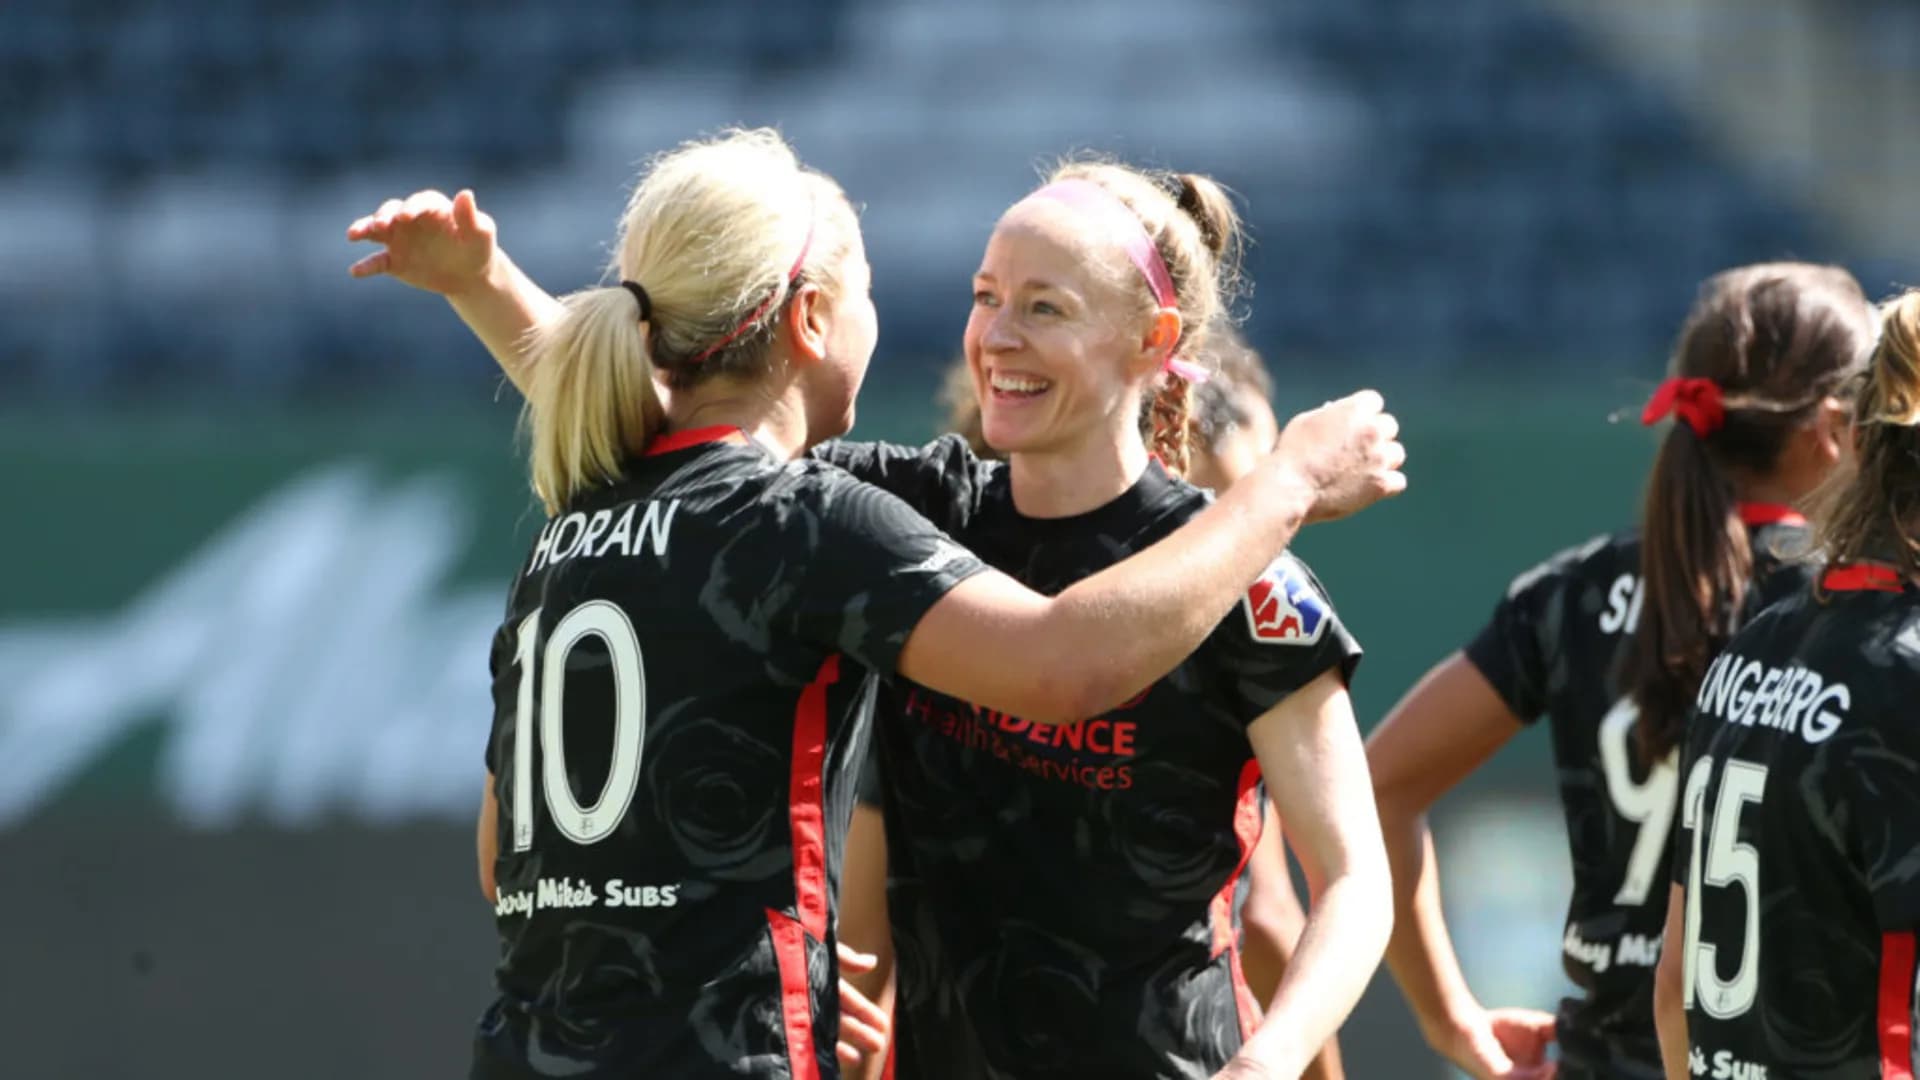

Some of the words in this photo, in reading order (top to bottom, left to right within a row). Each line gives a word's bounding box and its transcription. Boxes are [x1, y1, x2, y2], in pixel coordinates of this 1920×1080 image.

[527, 499, 681, 577] HORAN
[512, 599, 647, 852] 10
[905, 687, 989, 752] Halth
[1599, 697, 1680, 906] 9
